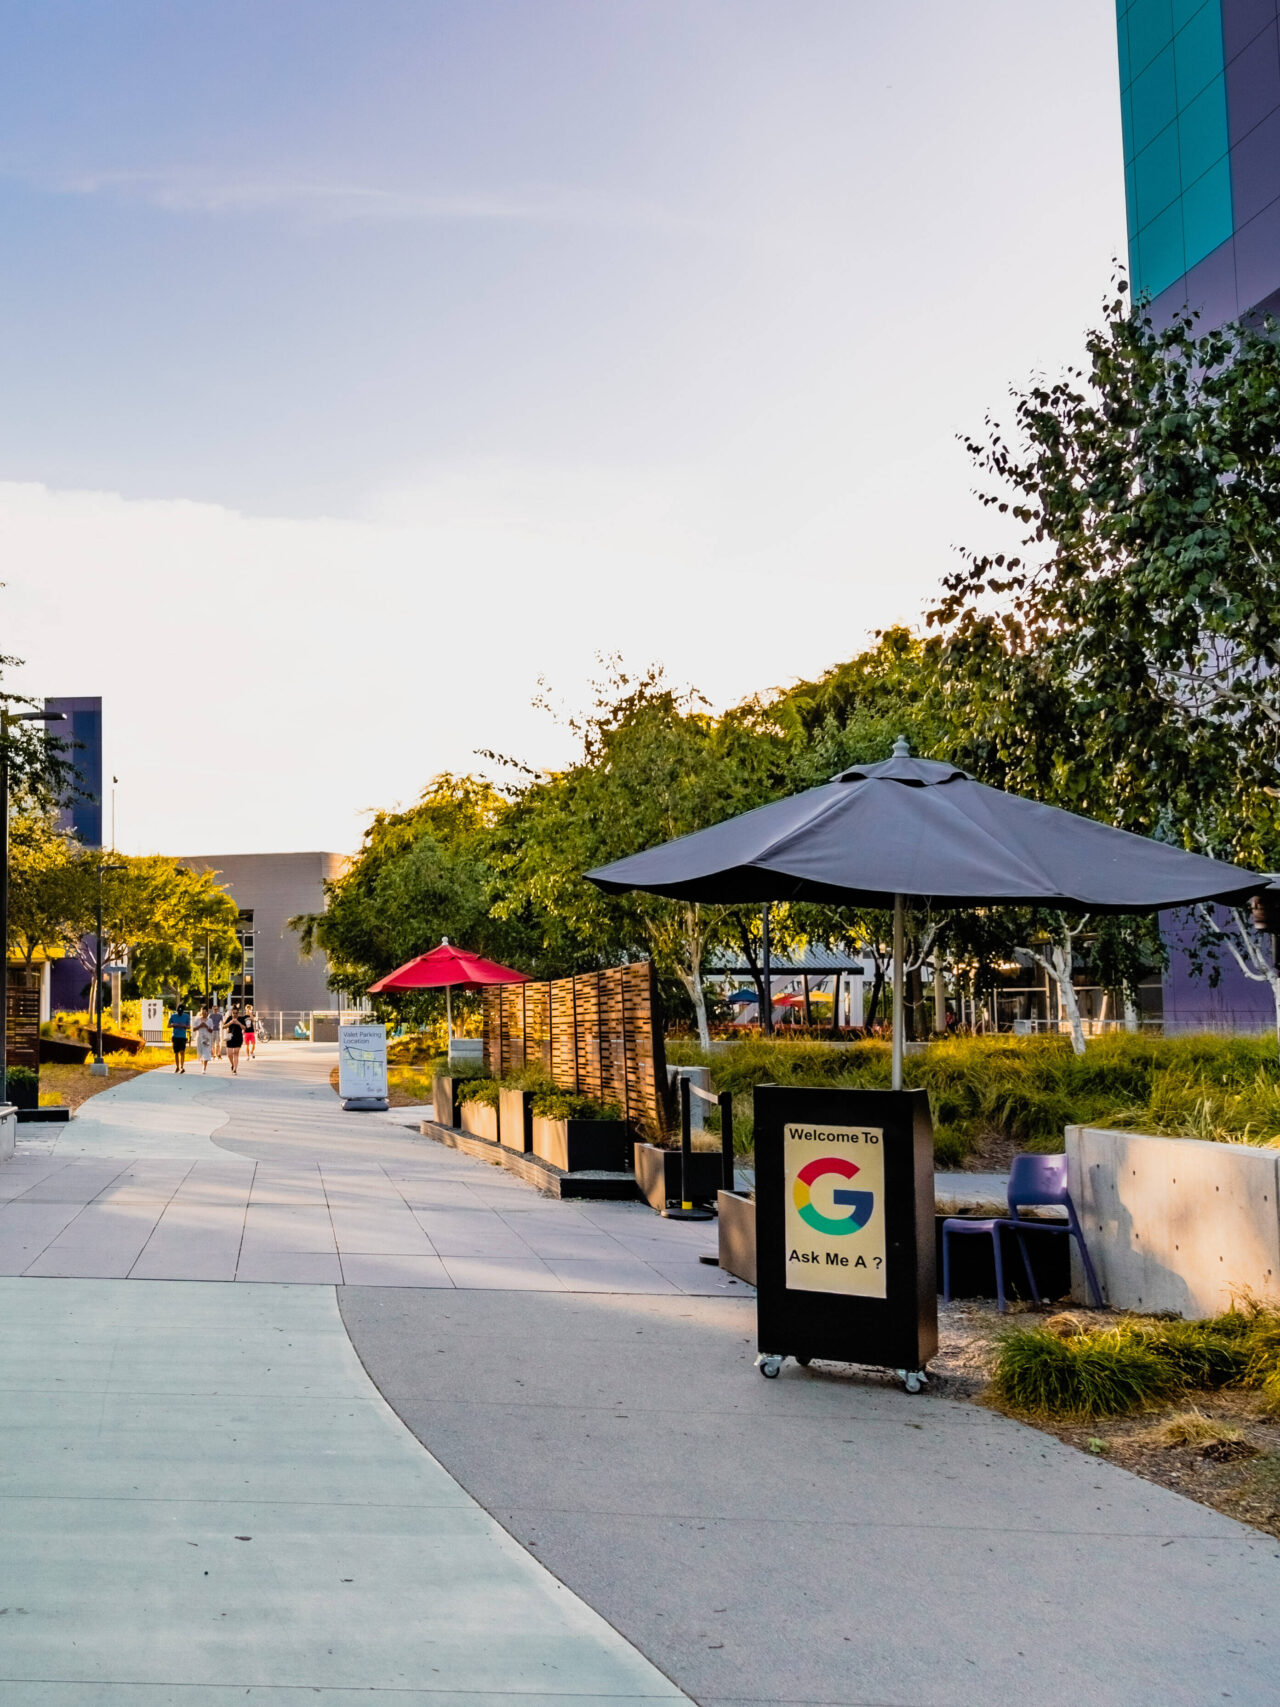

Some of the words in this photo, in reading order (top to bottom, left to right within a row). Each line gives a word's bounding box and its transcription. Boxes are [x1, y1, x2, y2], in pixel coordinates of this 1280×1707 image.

[789, 1128, 860, 1144] Welcome
[861, 1131, 879, 1145] To
[792, 1157, 874, 1236] G
[788, 1249, 821, 1265] Ask
[825, 1252, 849, 1267] Me
[854, 1255, 868, 1269] A
